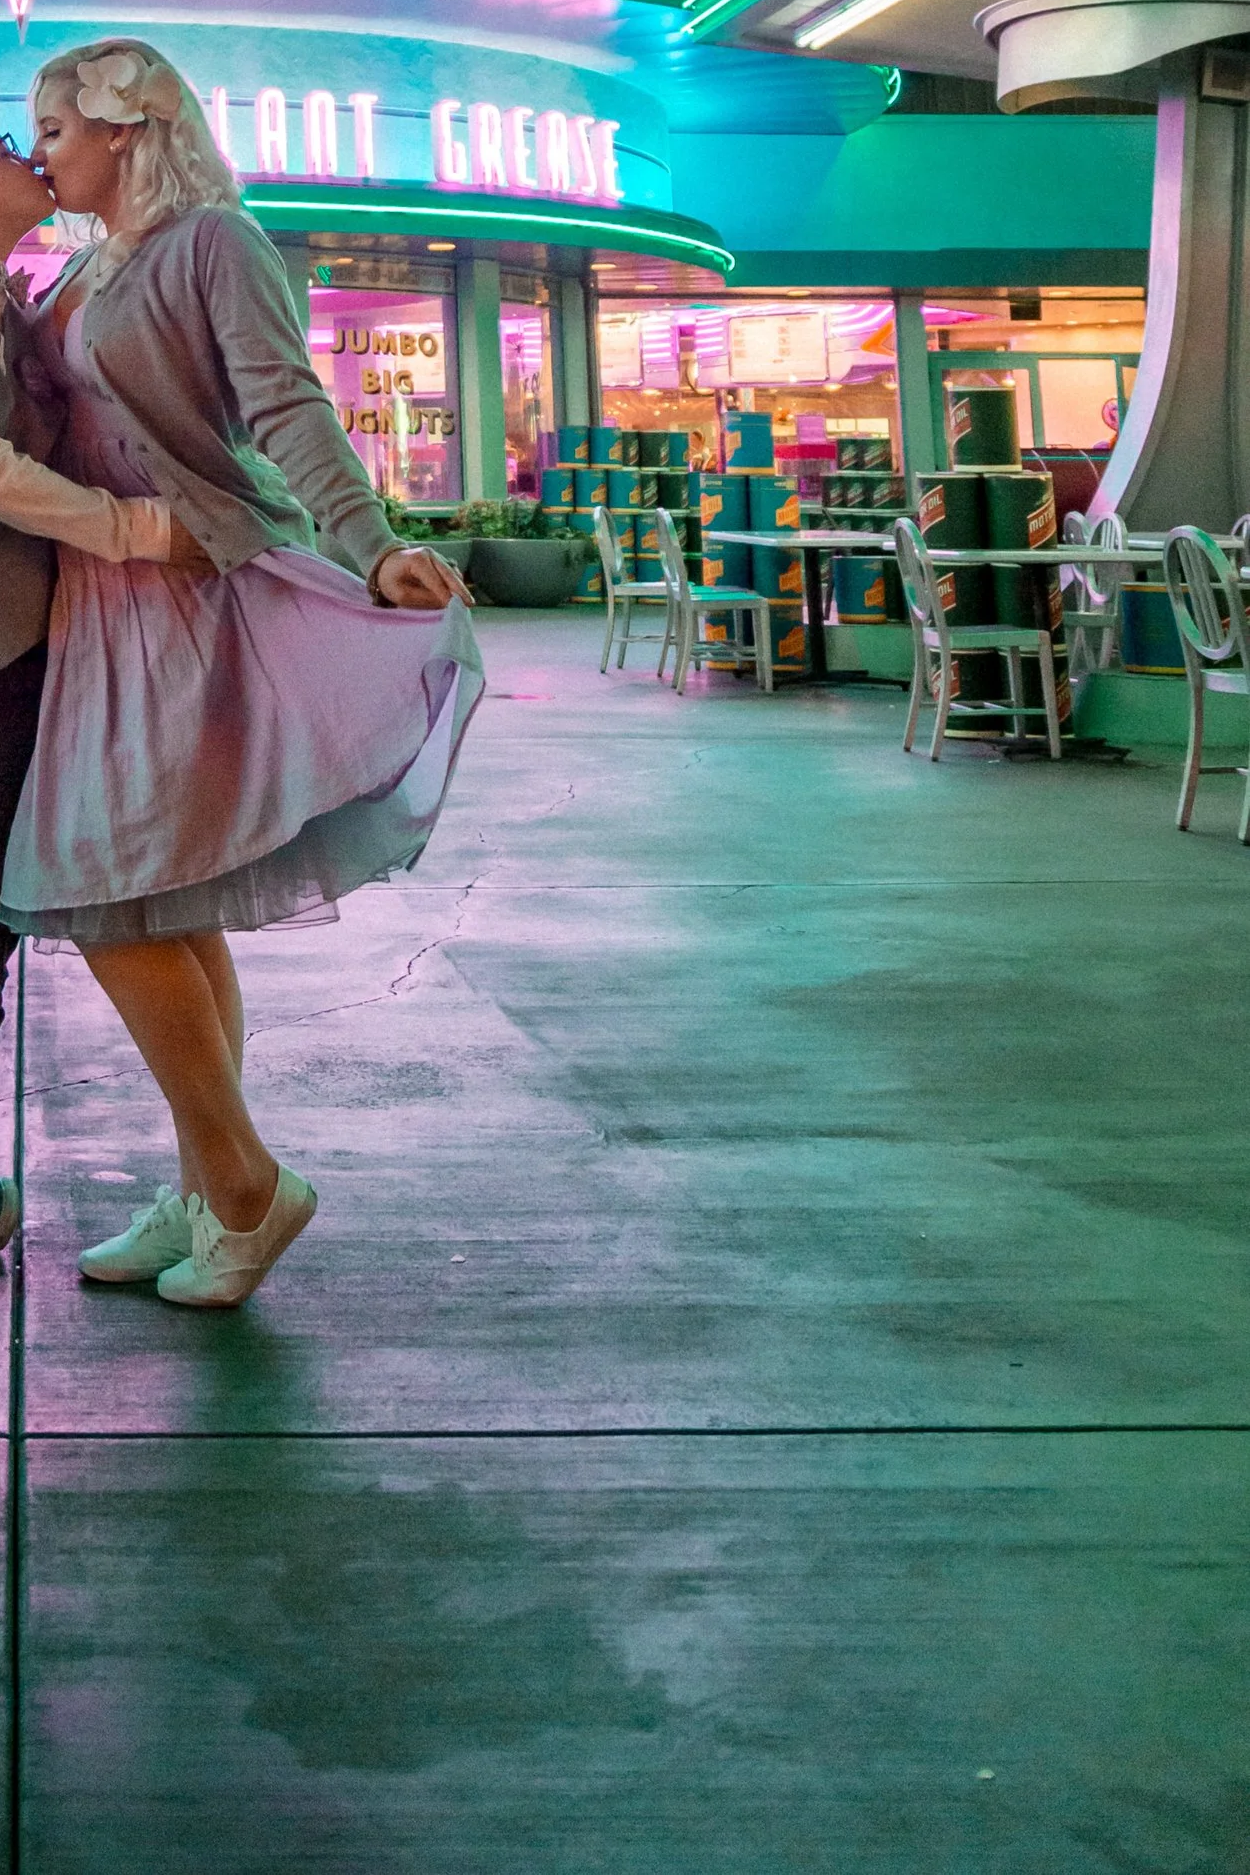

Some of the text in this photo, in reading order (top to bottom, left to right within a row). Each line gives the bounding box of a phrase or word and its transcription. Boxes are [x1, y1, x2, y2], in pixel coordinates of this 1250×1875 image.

[187, 78, 379, 176] LANT
[431, 98, 626, 200] GREASE
[330, 328, 438, 357] JUMBO
[361, 368, 415, 395] BIG
[337, 407, 455, 436] UGNUTS
